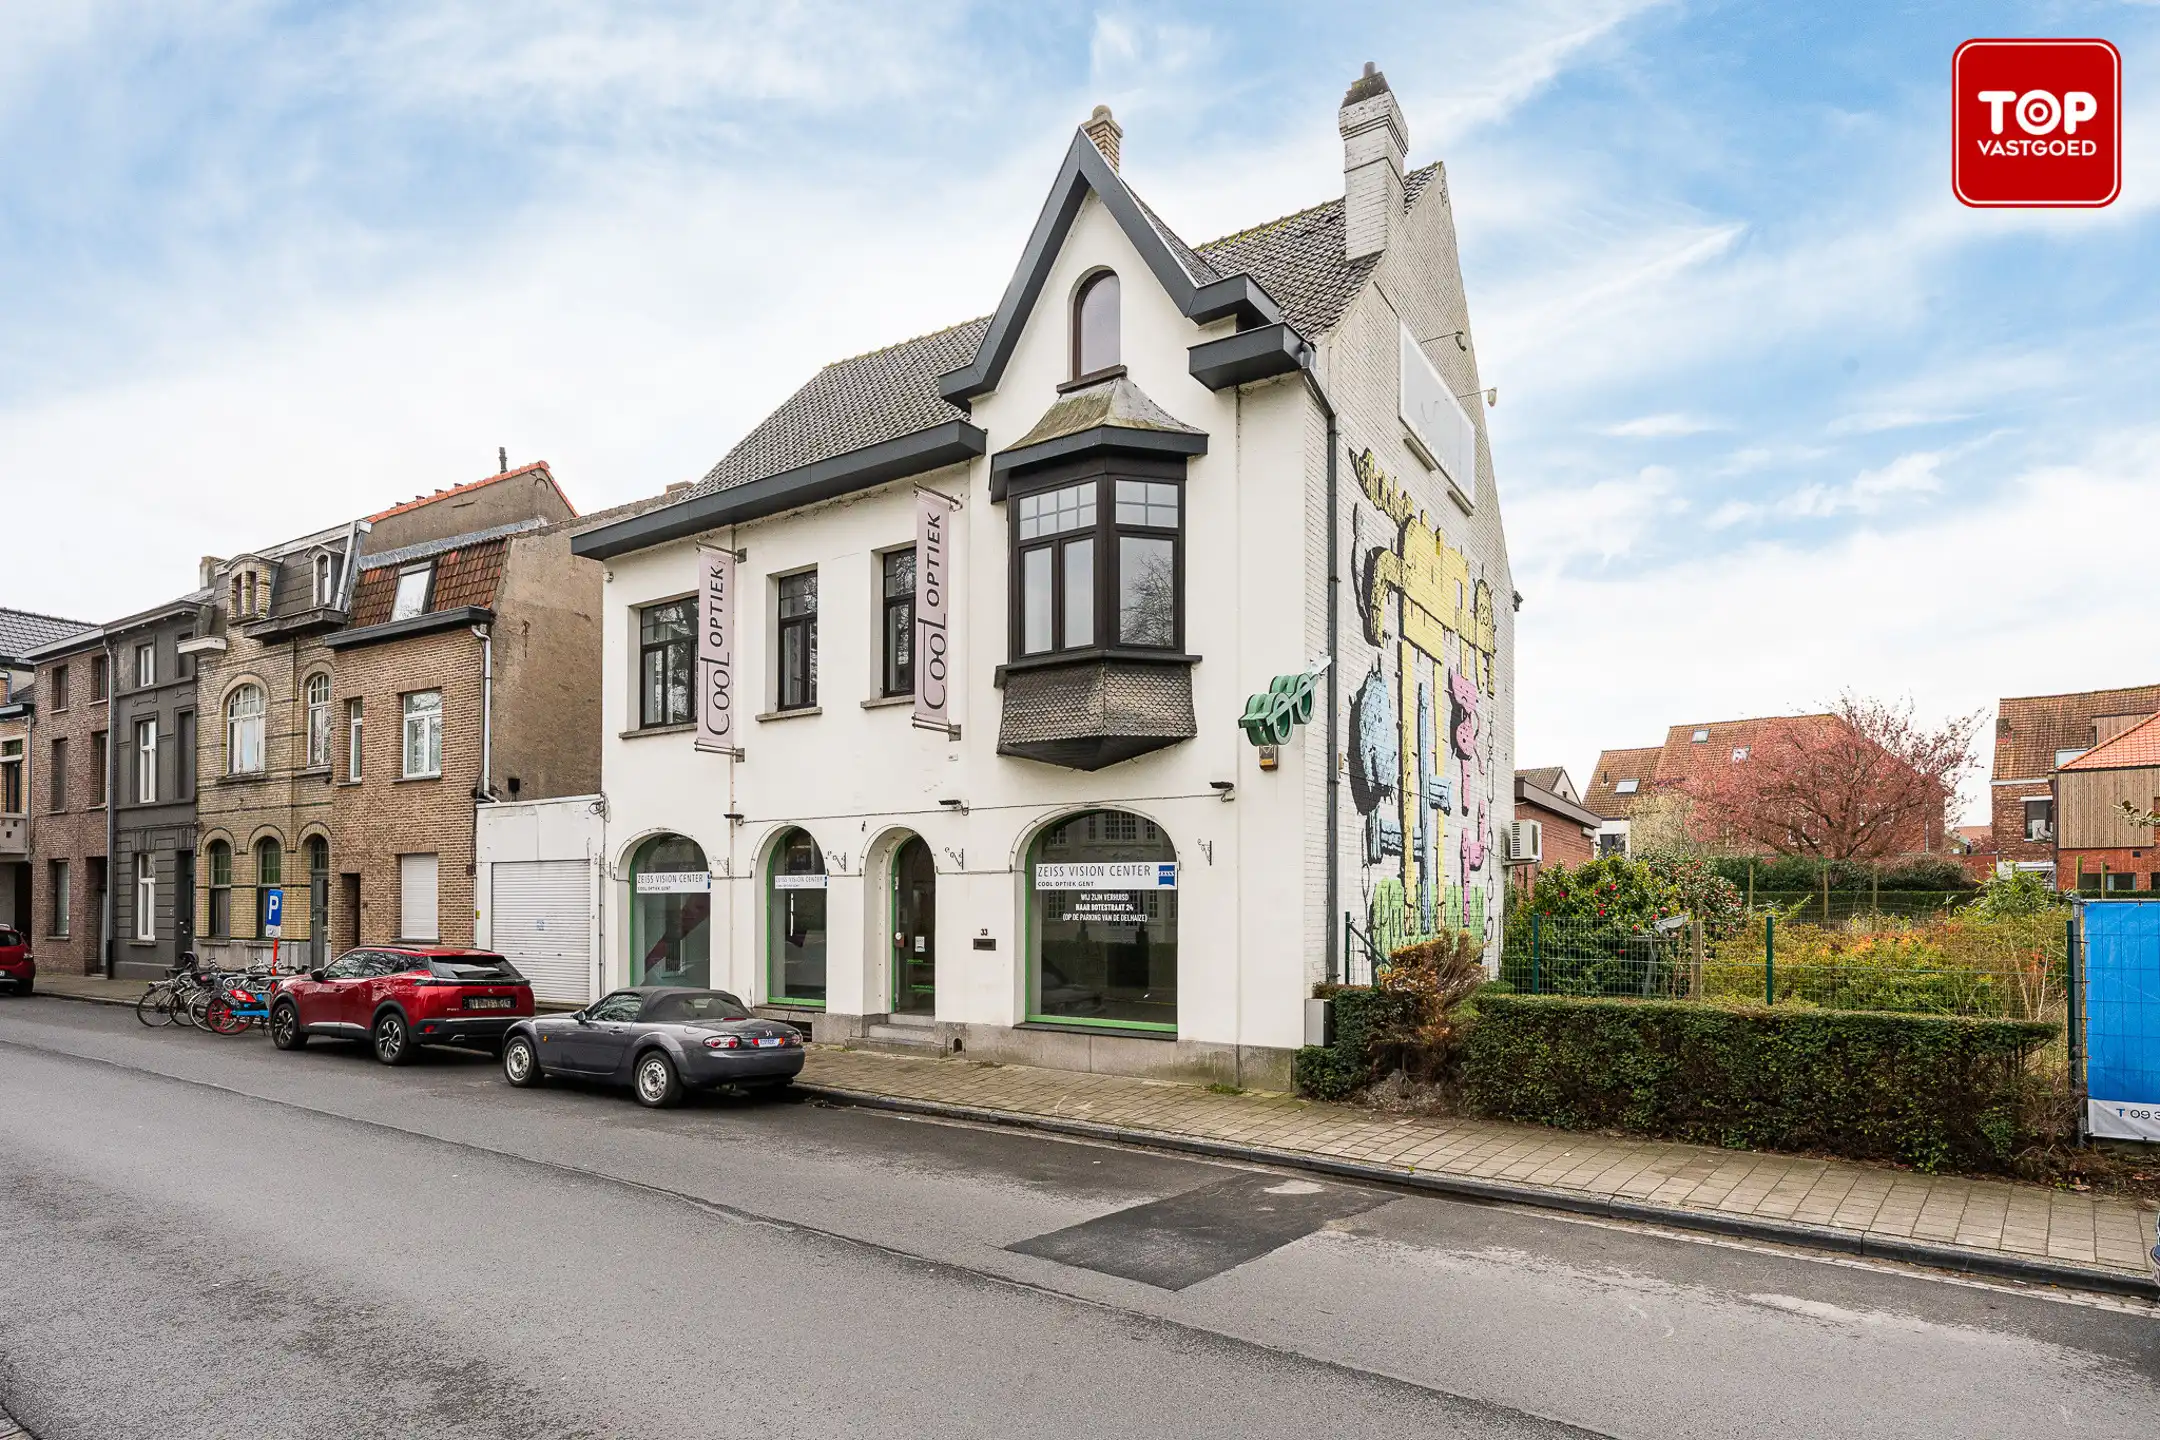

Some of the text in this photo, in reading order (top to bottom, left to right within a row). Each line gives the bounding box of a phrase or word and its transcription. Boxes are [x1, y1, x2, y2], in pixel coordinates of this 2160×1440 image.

[918, 511, 947, 710] COOL OPTIEK
[700, 565, 730, 736] COOL OPTIEK
[1038, 865, 1151, 877] ZEISS VISION CENTER
[637, 873, 704, 884] ZEISS VISION CENTER
[1091, 893, 1103, 901] ZIJN
[1104, 893, 1129, 901] VERHUISD
[269, 896, 279, 920] P
[1075, 903, 1091, 911] NAAR
[1091, 903, 1126, 911] BOTESTRAAT
[1062, 913, 1072, 921] (OP
[1072, 913, 1080, 921] DE
[1080, 913, 1102, 921] PARKING
[1102, 913, 1113, 921] VAN
[1113, 913, 1120, 921] DE
[980, 928, 988, 936] 33
[2116, 1108, 2126, 1117] T
[2130, 1109, 2151, 1120] 09
